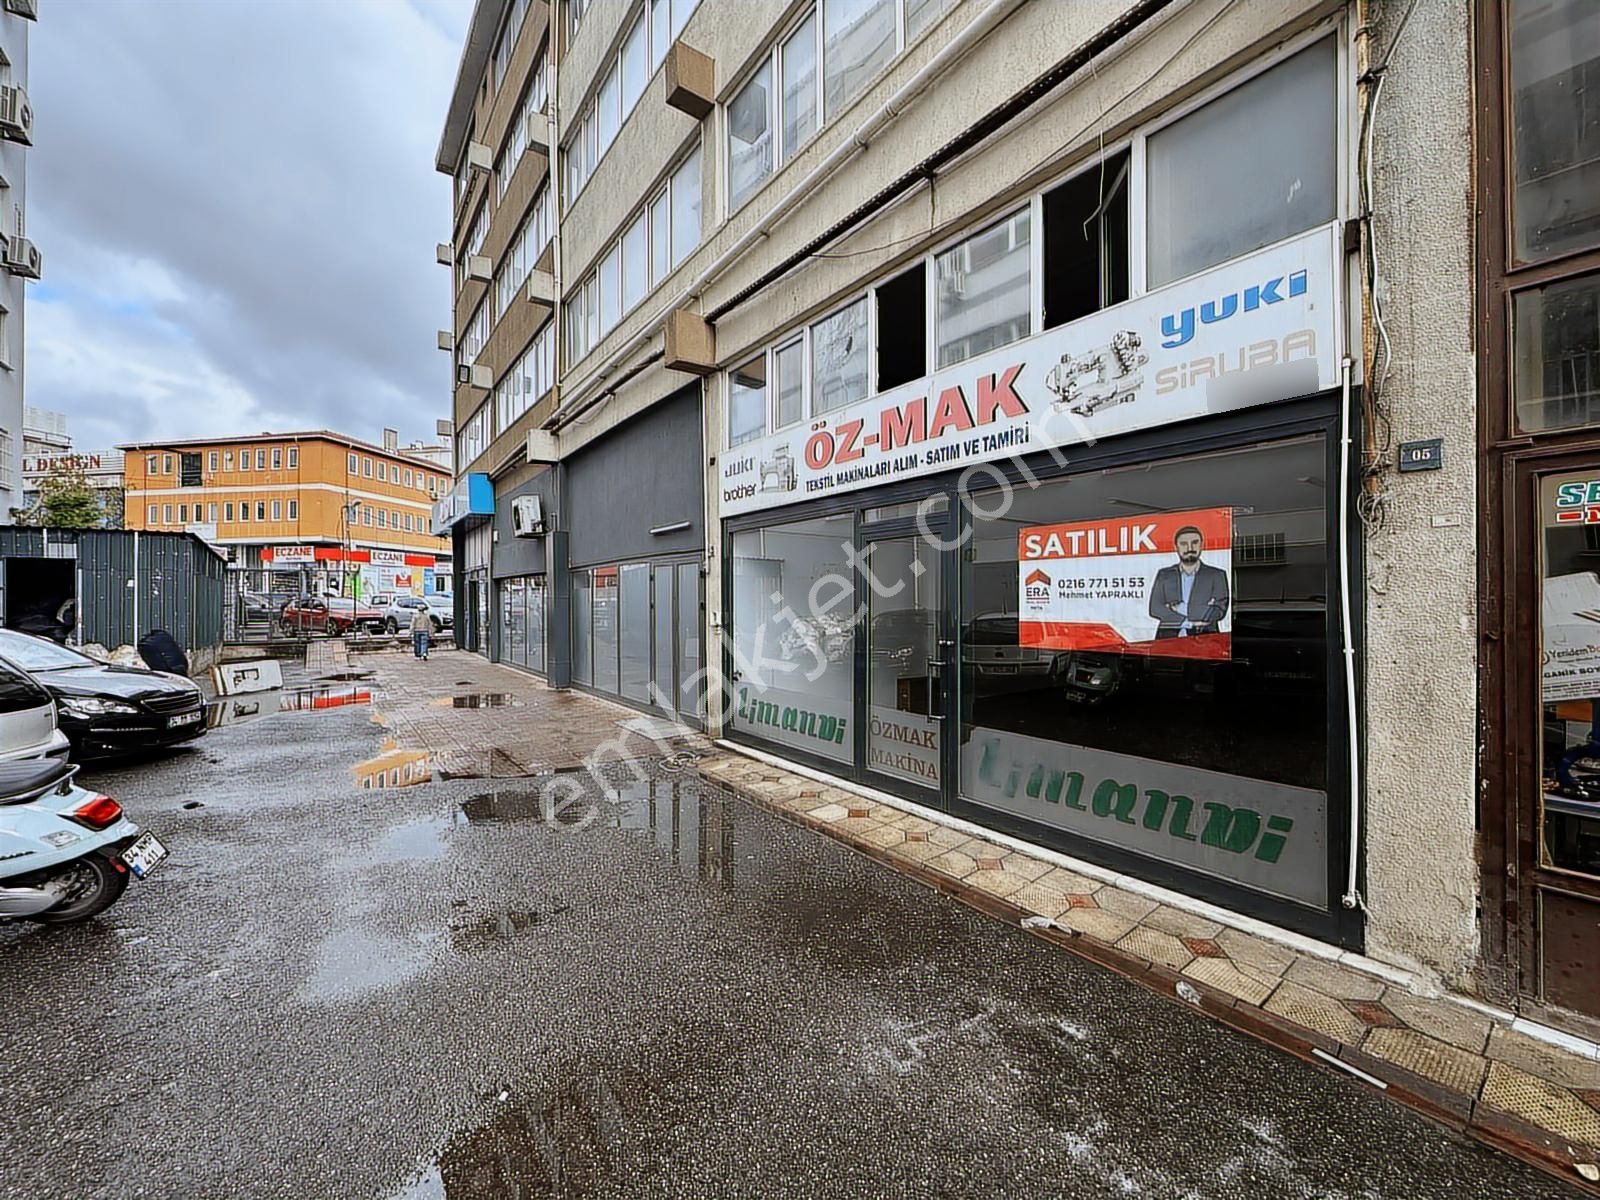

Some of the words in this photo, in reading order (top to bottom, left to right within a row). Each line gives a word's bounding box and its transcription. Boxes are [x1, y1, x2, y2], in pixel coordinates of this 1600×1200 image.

[803, 362, 1031, 471] ÖZ-MAK
[806, 472, 835, 493] TEKSTİL
[836, 460, 891, 486] MAKİNALARI
[893, 454, 919, 473] ALIM
[926, 444, 961, 467] SATIM
[964, 437, 980, 456] VE
[982, 420, 1030, 450] TAMİRİ
[1412, 448, 1431, 461] 05
[723, 483, 757, 503] brother
[1025, 524, 1158, 559] SATILIK
[275, 547, 312, 557] ECZANE
[1026, 586, 1050, 597] ERA
[1058, 578, 1086, 589] 0216
[1089, 577, 1108, 588] 771
[1112, 577, 1125, 588] 51
[1128, 576, 1145, 588] 53
[1095, 589, 1144, 599] YAPRAKLI
[869, 714, 938, 750] ÖZMAK
[870, 746, 939, 780] MAKİNA
